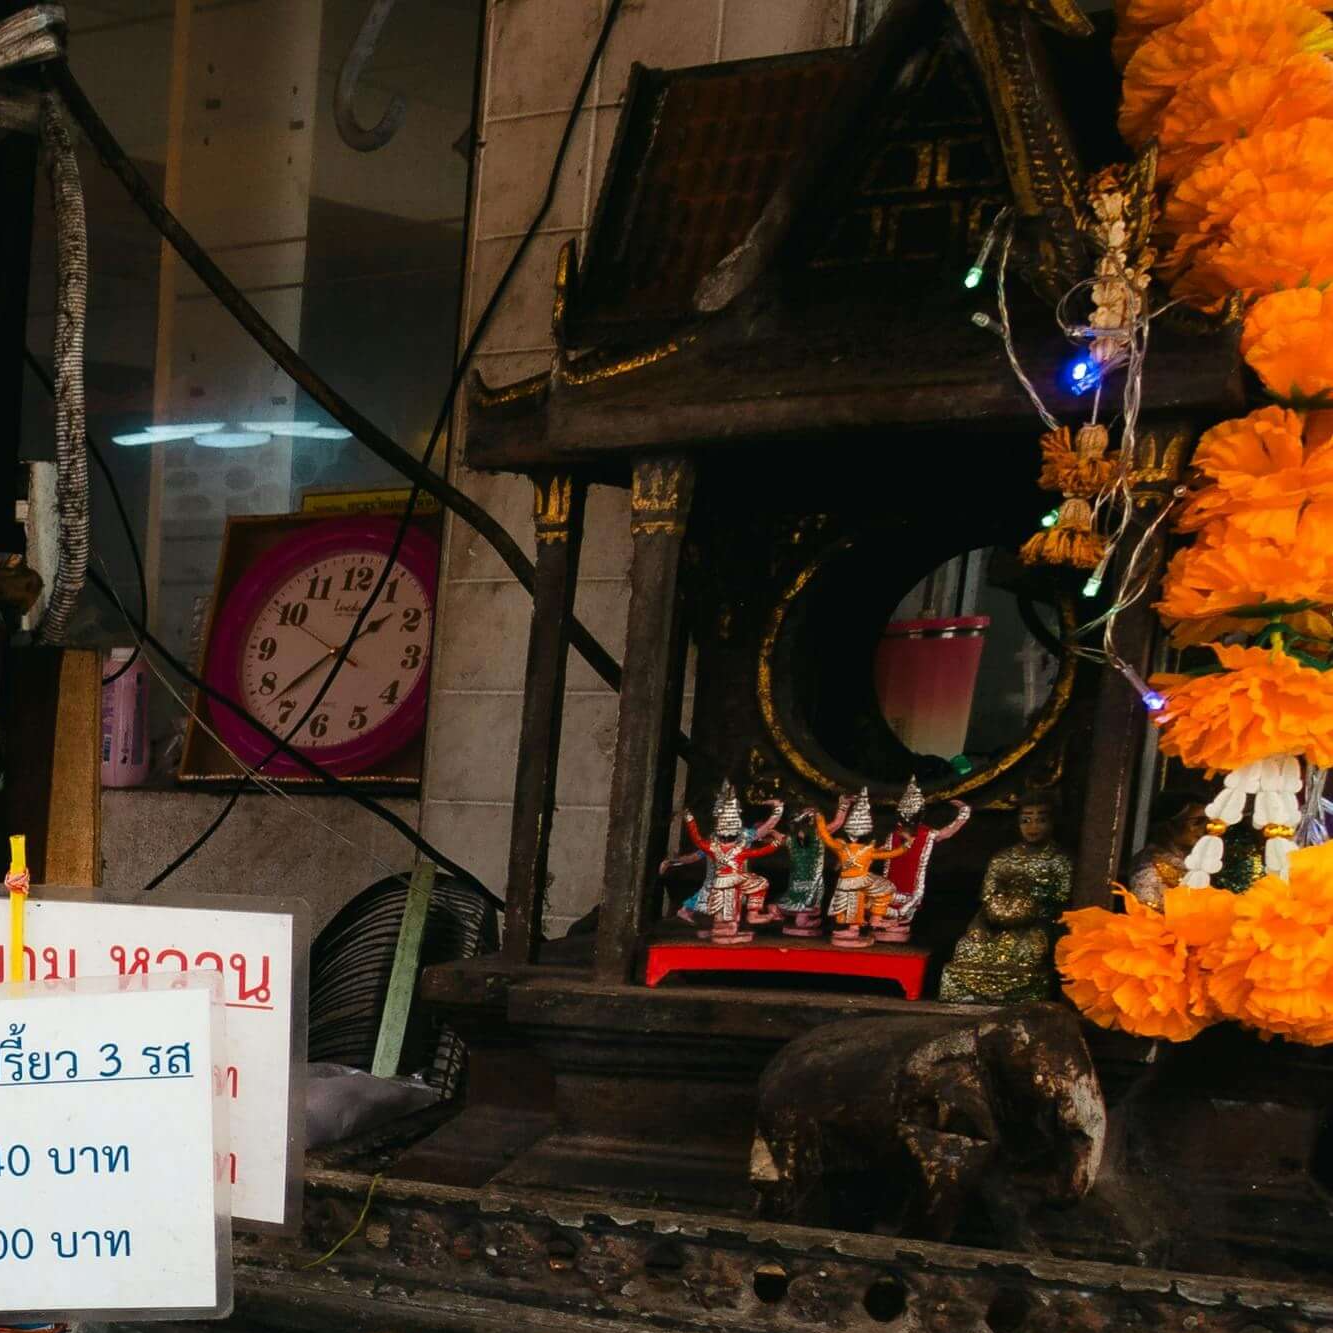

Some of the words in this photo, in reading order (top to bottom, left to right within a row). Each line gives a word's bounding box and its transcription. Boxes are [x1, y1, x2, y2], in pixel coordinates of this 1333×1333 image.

[305, 574, 332, 600] 11
[342, 566, 375, 592] 12
[382, 579, 396, 603] 1
[276, 602, 308, 627] 10
[400, 608, 422, 632] 2
[258, 638, 277, 661] 9
[401, 644, 422, 670] 3
[259, 671, 277, 696] 8
[379, 680, 400, 704] 4
[278, 700, 296, 724] 7
[348, 706, 368, 730] 5
[310, 714, 329, 738] 6
[109, 944, 272, 1005] หวาน
[98, 1042, 123, 1078] 3
[141, 1039, 193, 1077] รส
[47, 1140, 132, 1177] บาท
[49, 1226, 133, 1260] บาท
